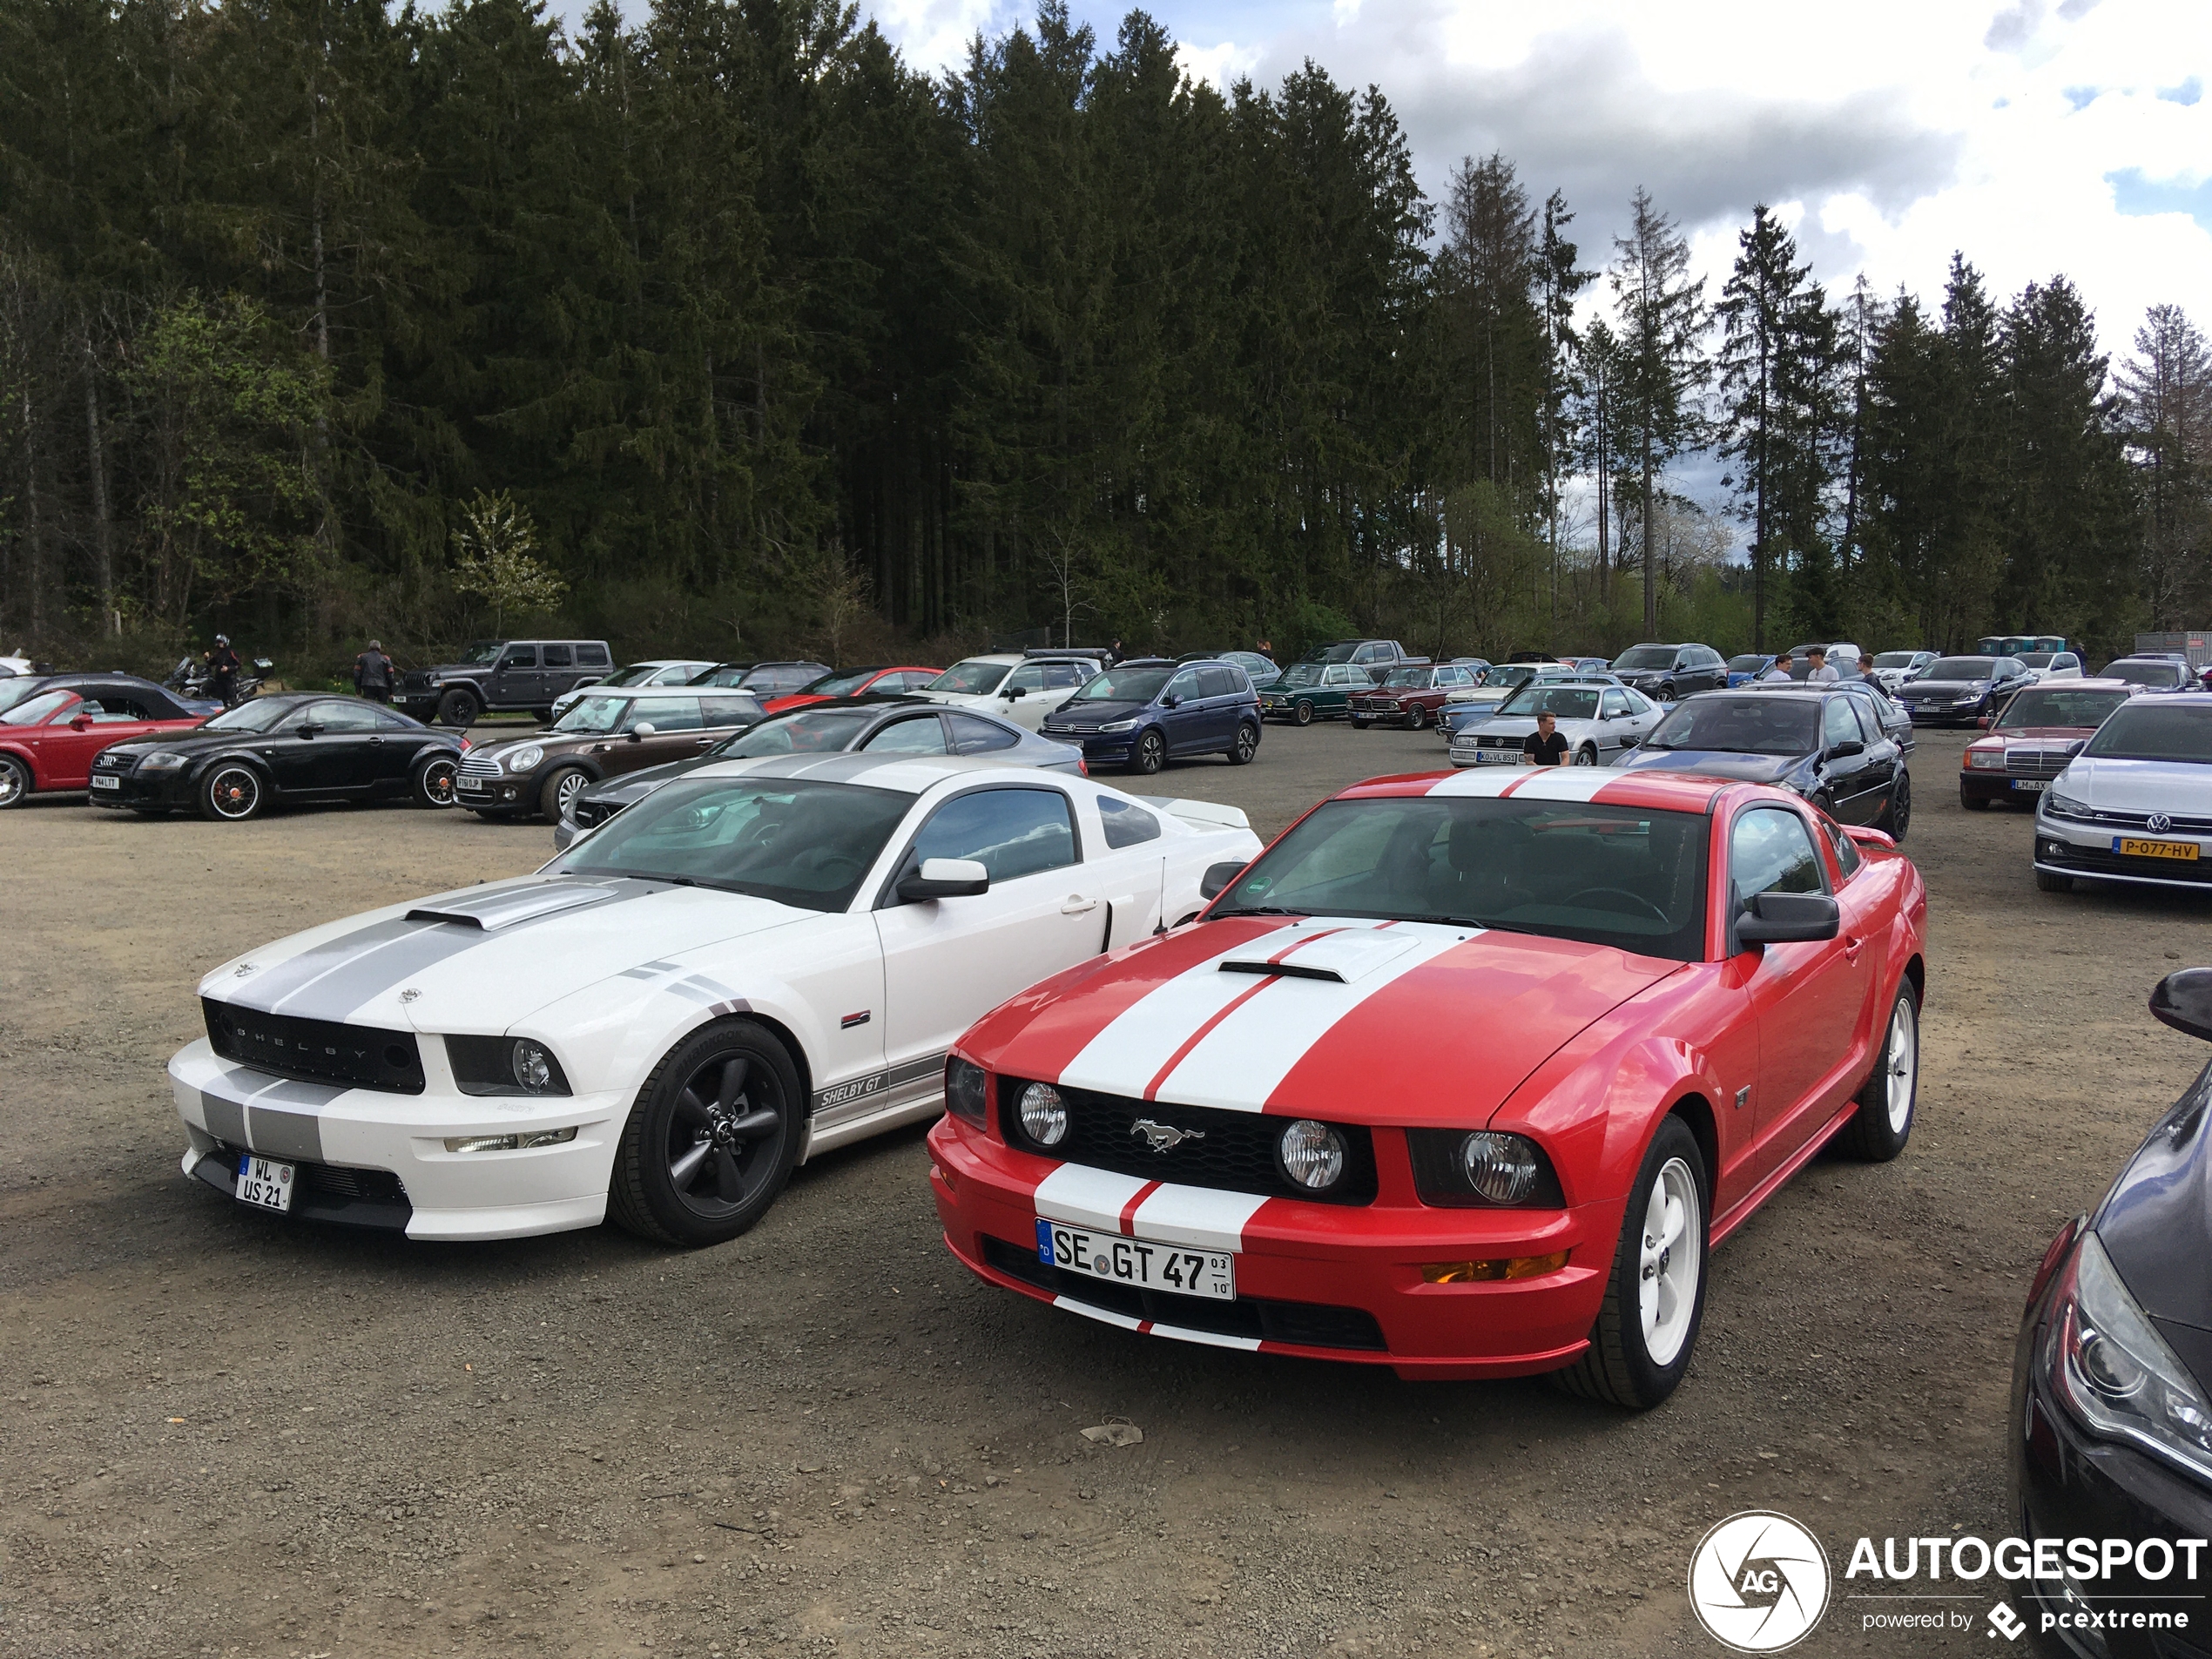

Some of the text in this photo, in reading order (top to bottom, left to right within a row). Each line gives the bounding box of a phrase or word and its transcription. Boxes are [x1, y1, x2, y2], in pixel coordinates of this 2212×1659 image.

[105, 779, 115, 787] LTT
[2016, 780, 2028, 789] LM
[2126, 841, 2192, 857] P-077-HV
[237, 1028, 366, 1058] SHELBY
[821, 1076, 881, 1106] SHELBY GT
[255, 1159, 272, 1182] WL
[244, 1179, 280, 1207] US 21
[1055, 1230, 1204, 1290] SE GT 47
[1211, 1258, 1226, 1269] 03
[1212, 1282, 1227, 1294] 10
